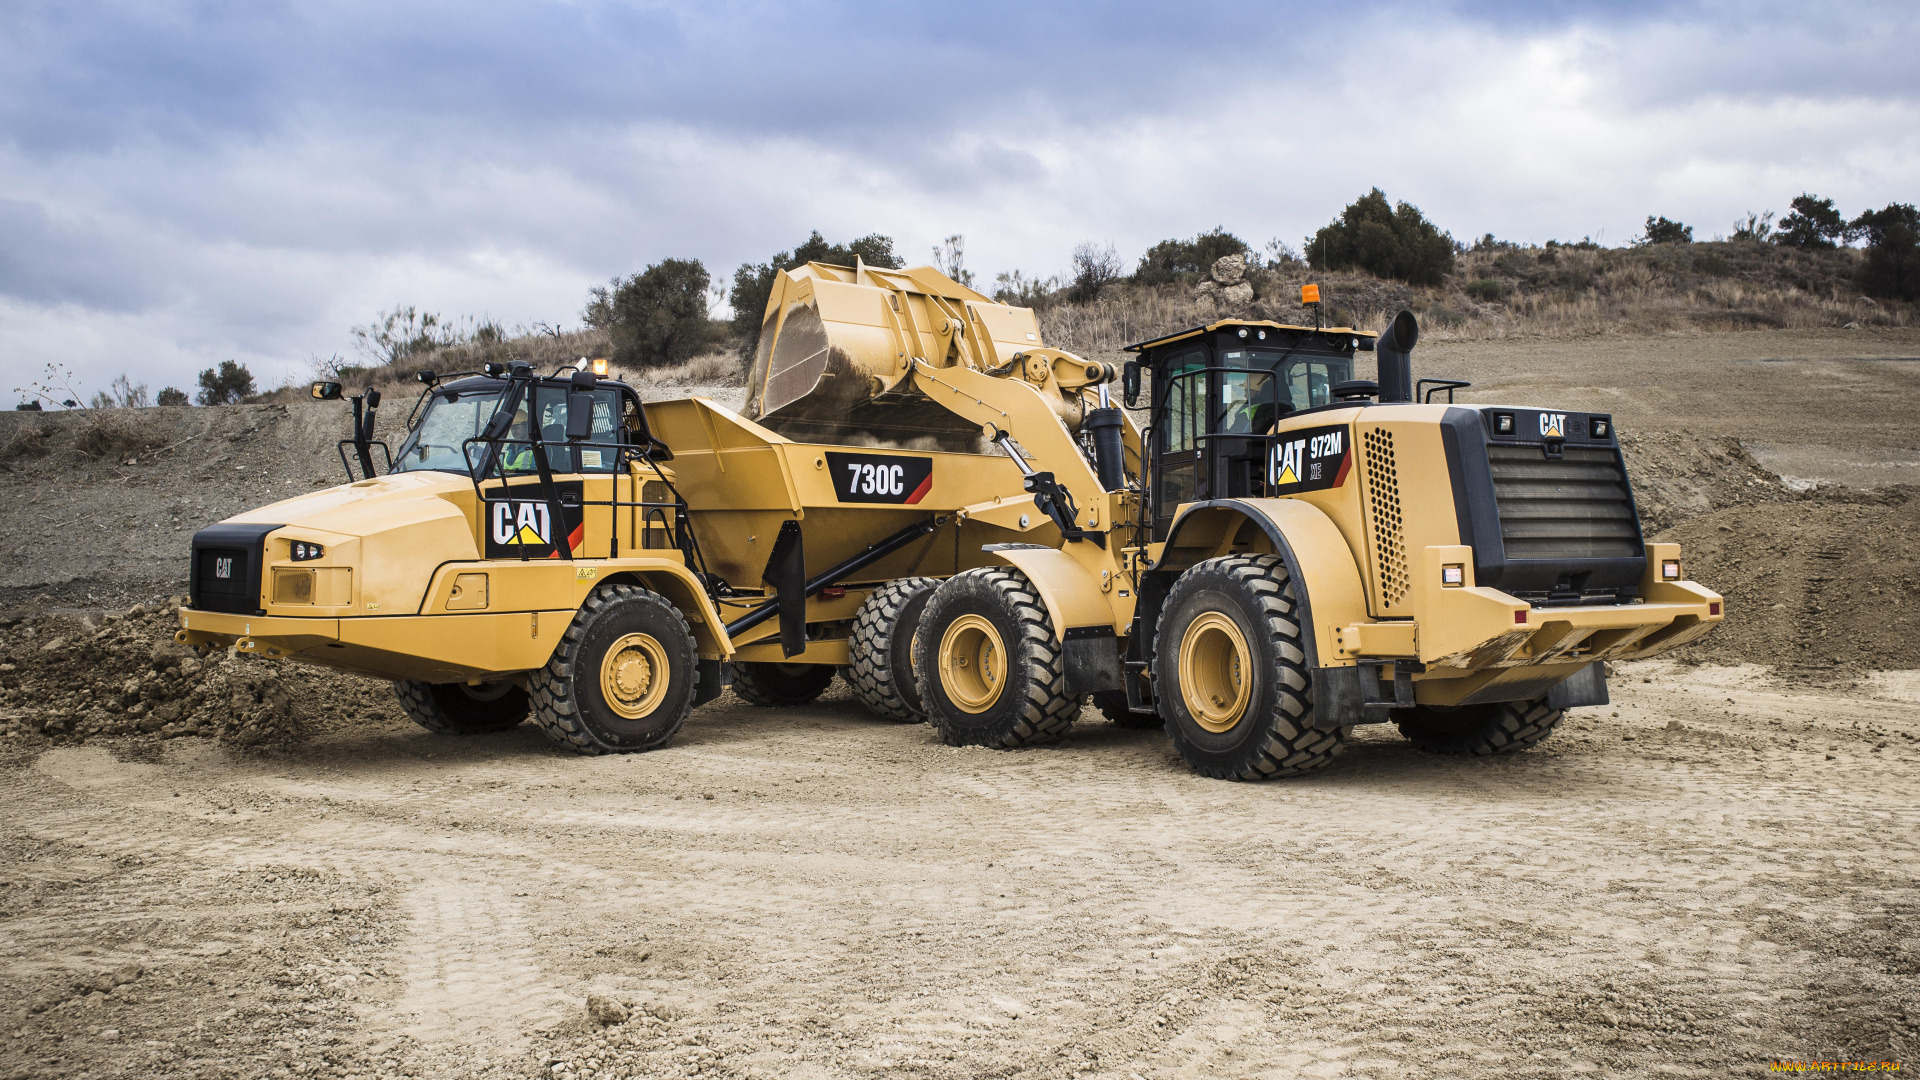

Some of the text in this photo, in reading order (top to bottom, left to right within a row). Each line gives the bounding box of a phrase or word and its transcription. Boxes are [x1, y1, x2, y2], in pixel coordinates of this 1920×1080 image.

[1539, 412, 1567, 437] CAT
[1269, 431, 1342, 486] CAT 972M
[848, 463, 904, 495] 730C
[493, 502, 551, 545] CAT
[216, 557, 233, 579] CAT
